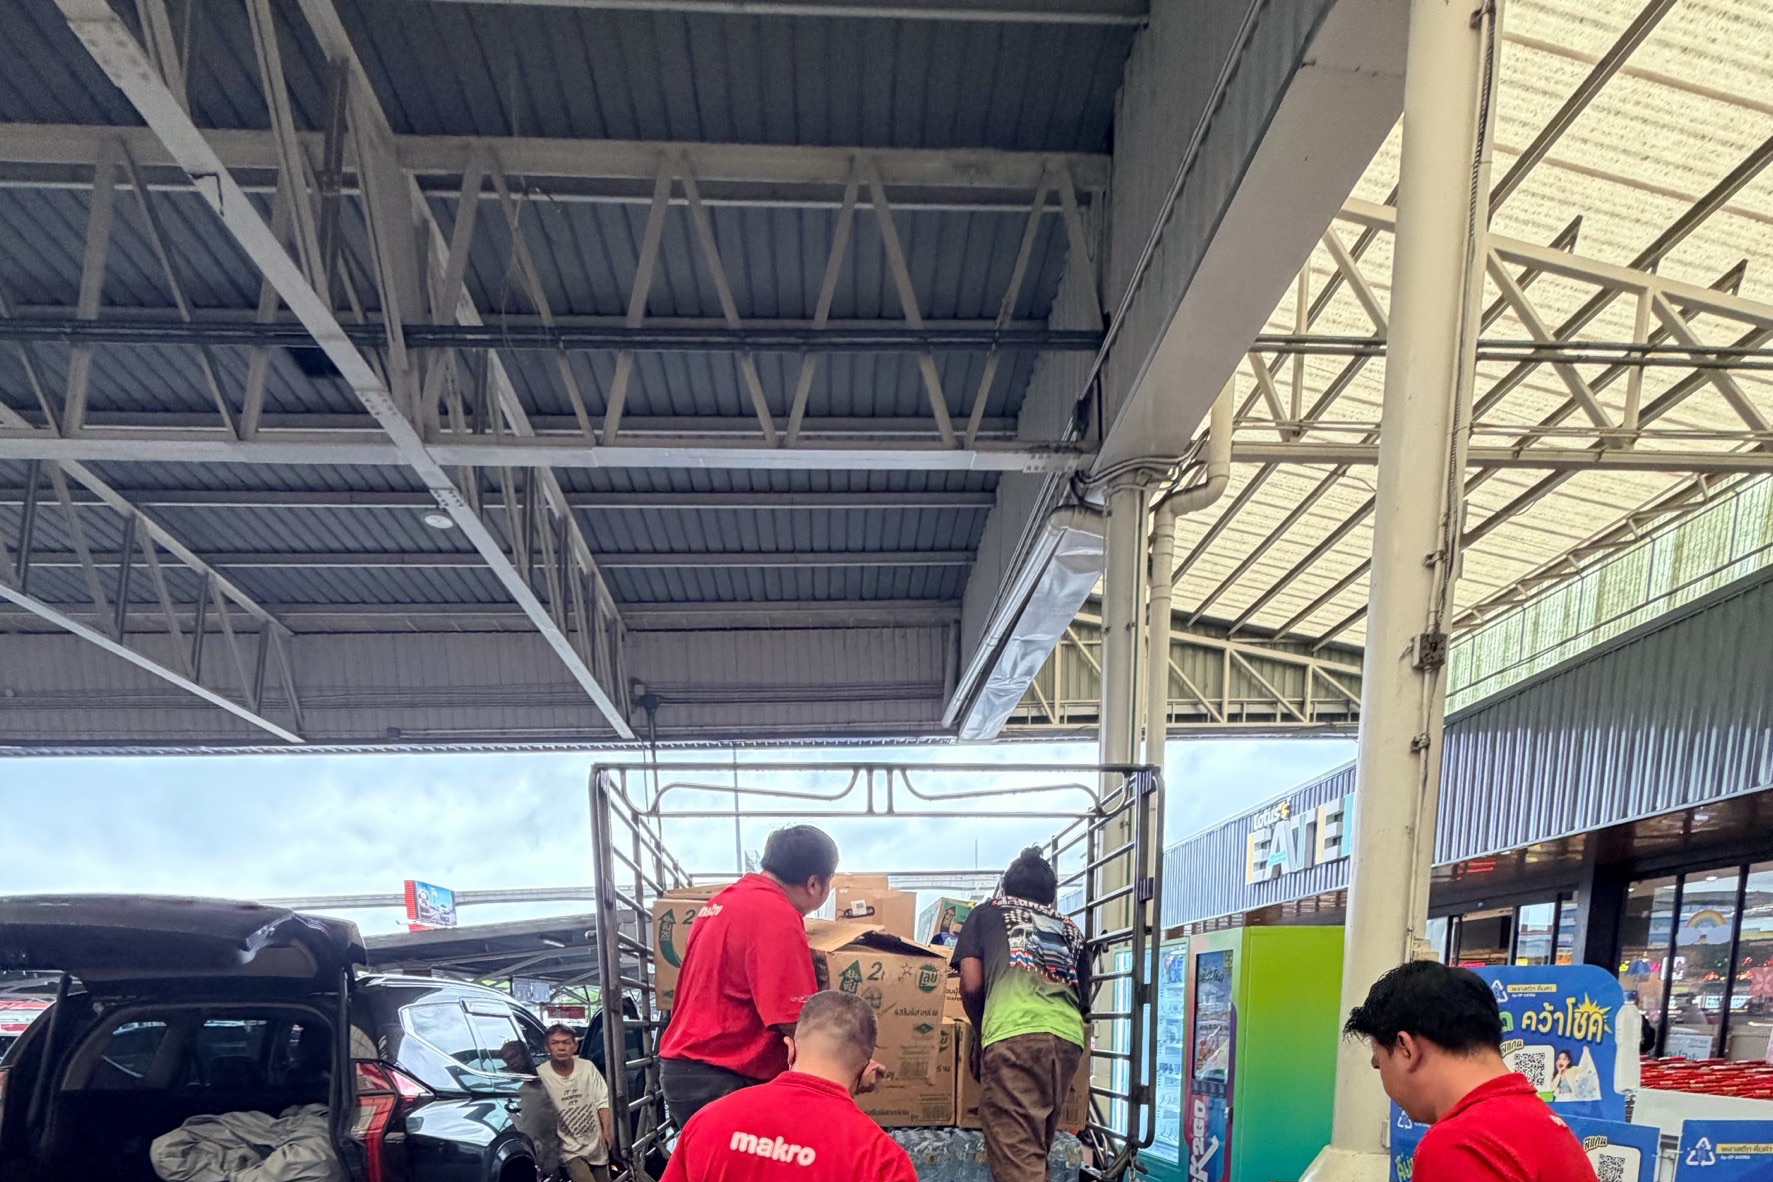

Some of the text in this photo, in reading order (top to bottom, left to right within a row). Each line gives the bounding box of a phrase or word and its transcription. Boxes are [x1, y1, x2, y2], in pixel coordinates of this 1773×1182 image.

[1521, 997, 1605, 1044] คว้าโชค
[729, 1131, 817, 1167] makro
